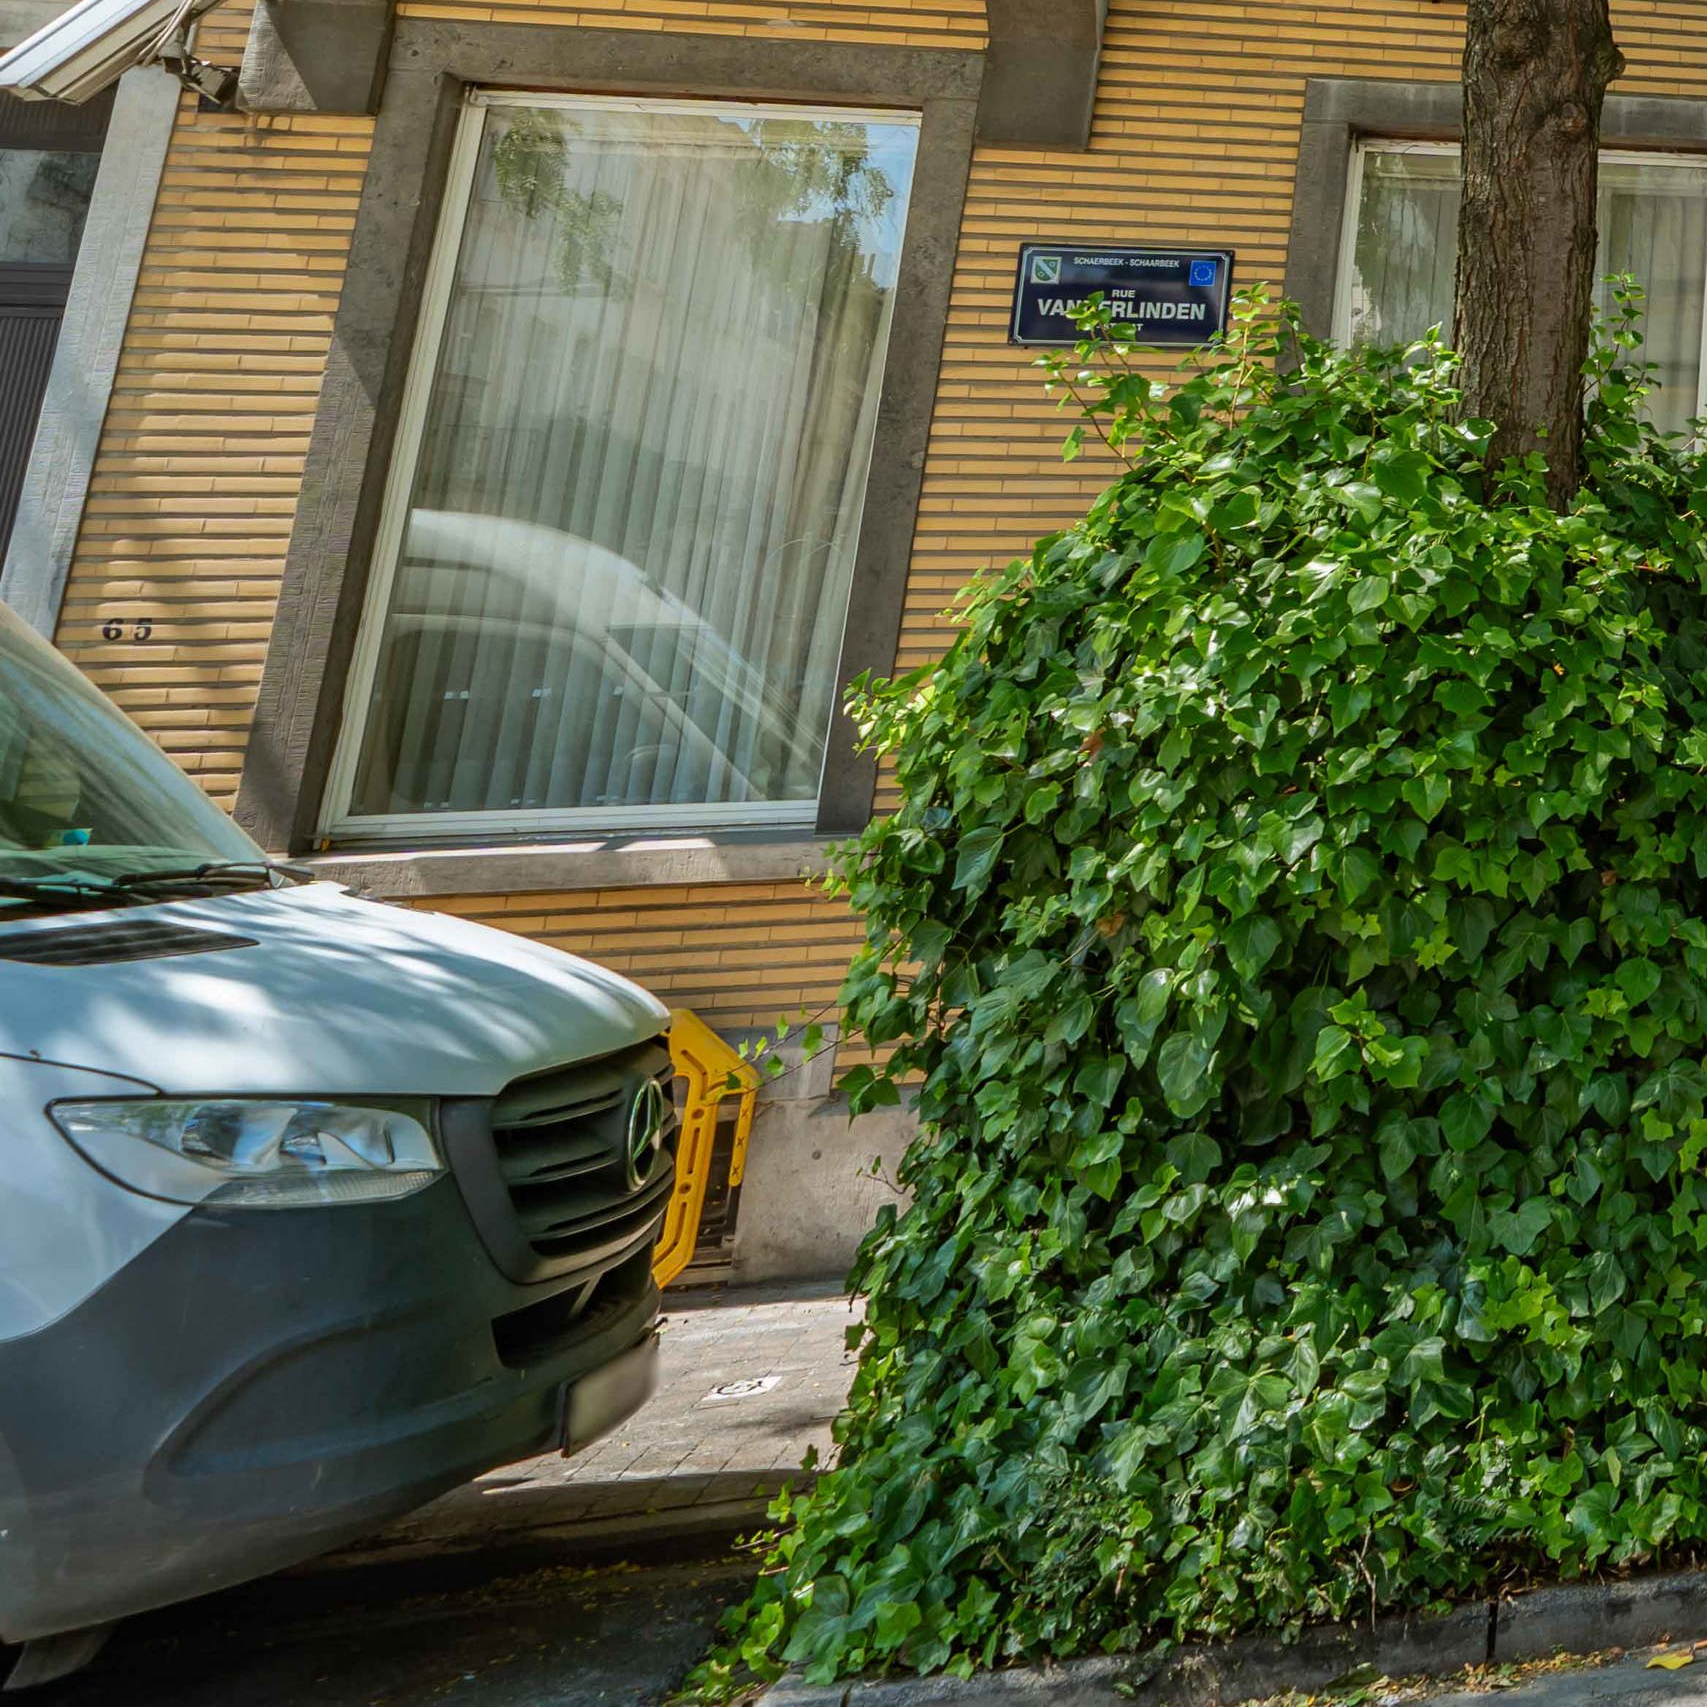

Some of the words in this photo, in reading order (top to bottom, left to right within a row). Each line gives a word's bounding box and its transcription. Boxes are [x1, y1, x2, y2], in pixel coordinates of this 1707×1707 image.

[1073, 256, 1124, 266] SCHAERBEEK
[1129, 258, 1180, 268] SCHAARBEEK
[1111, 289, 1135, 298] RUE
[1037, 298, 1206, 320] VANRLINDEN
[102, 617, 152, 642] 65
